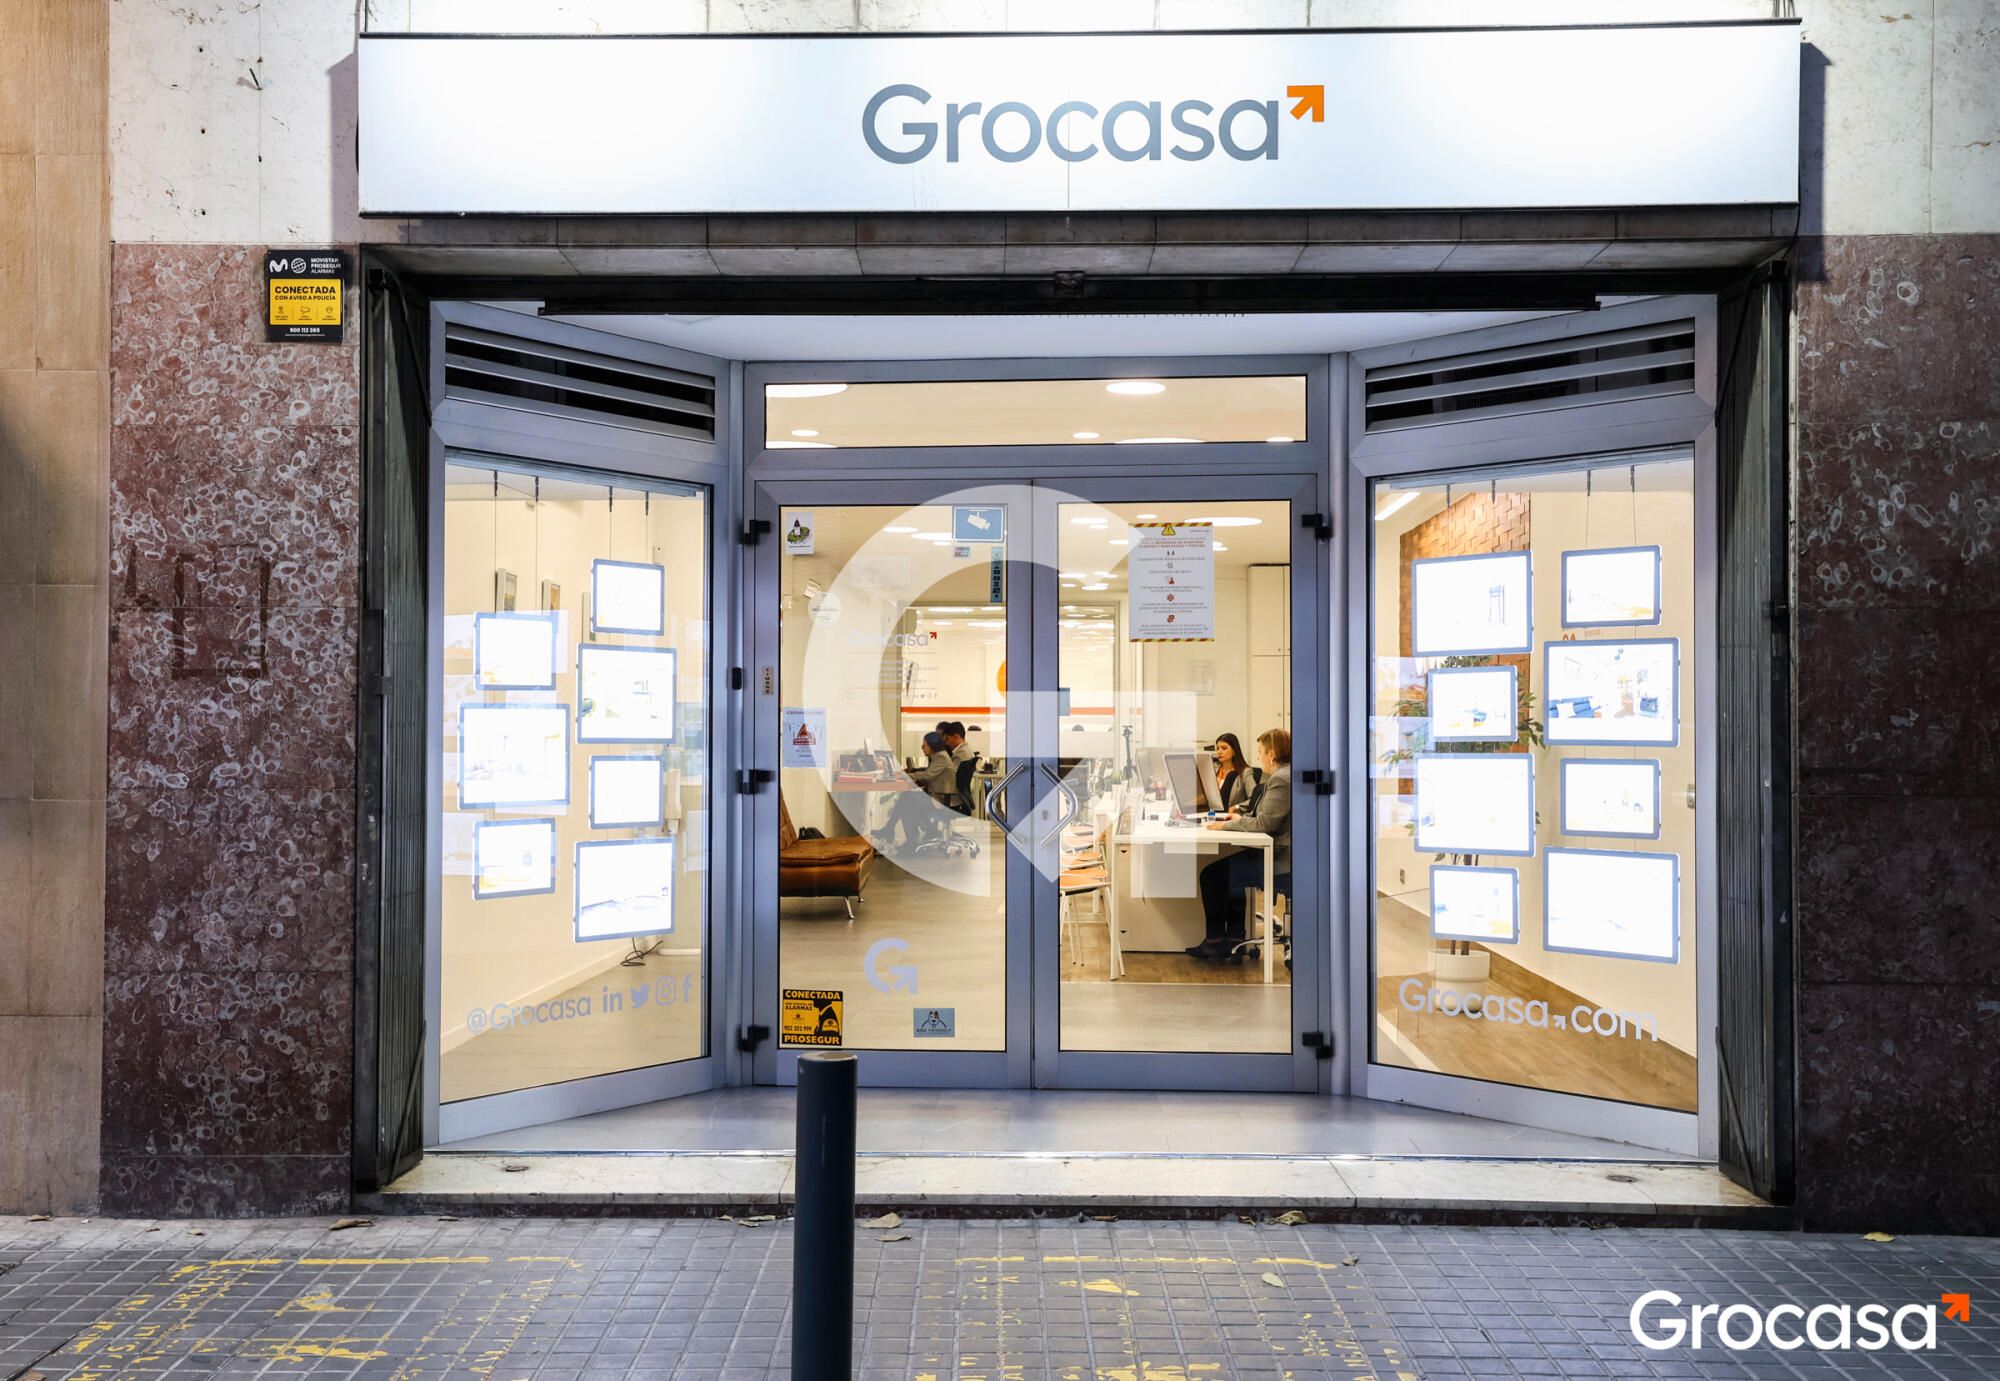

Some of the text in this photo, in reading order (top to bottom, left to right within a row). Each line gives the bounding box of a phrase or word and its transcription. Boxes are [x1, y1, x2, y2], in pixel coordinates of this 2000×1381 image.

[862, 83, 1279, 165] Grocasa
[274, 286, 336, 294] CONECTADA
[785, 990, 841, 1000] CONECTADA
[466, 995, 592, 1034] @Grocasa
[784, 1034, 841, 1045] PROSEGUR
